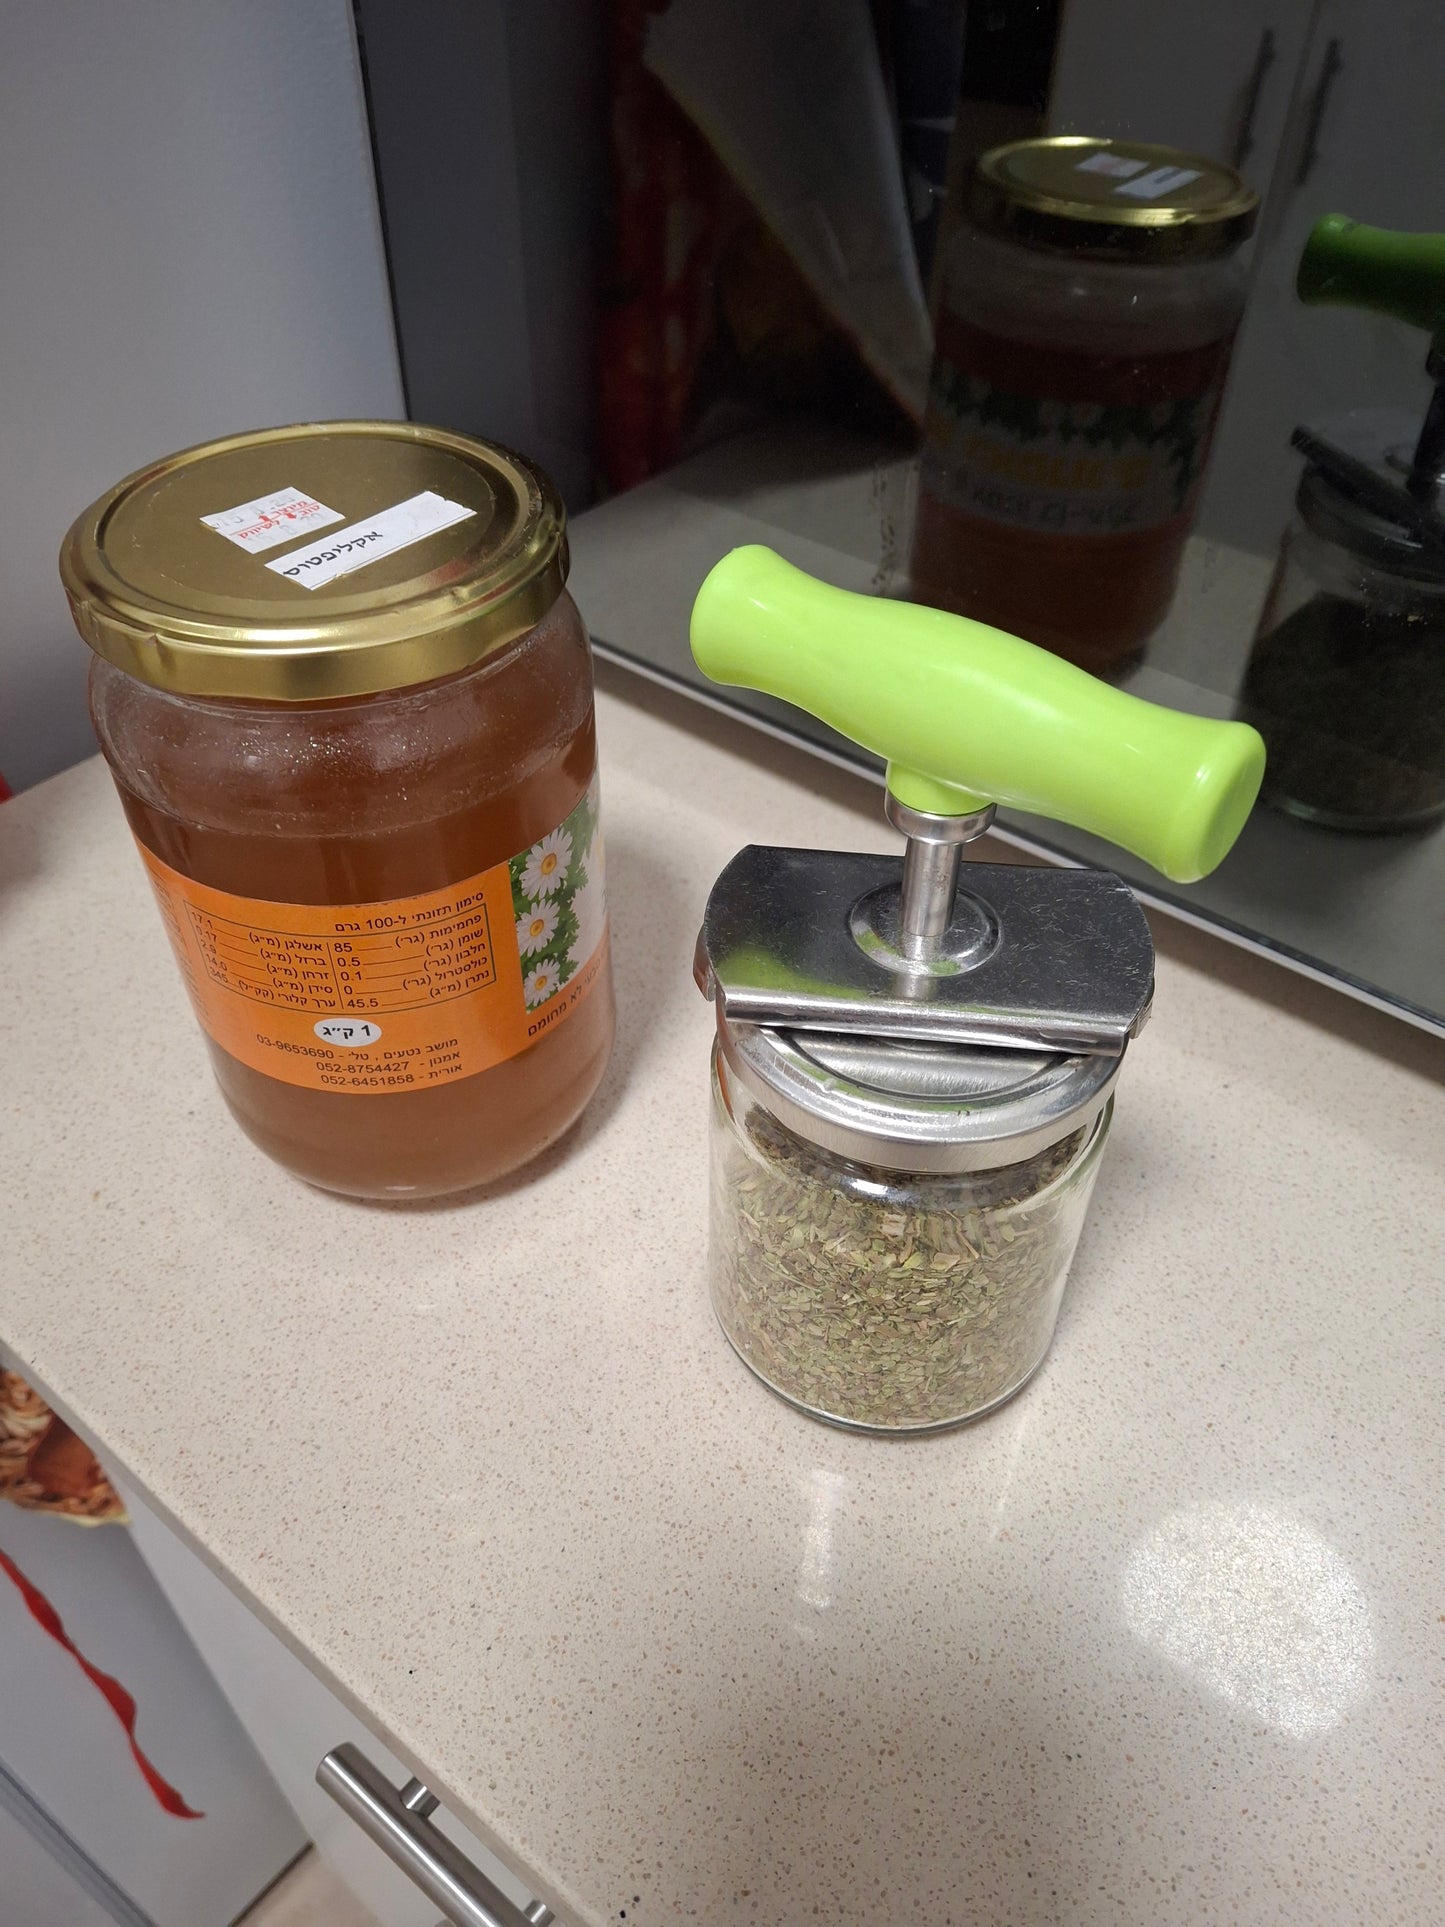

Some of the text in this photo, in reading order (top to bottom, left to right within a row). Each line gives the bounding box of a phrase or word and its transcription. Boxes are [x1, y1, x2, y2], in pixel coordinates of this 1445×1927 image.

[283, 531, 383, 575] אקליפטוס
[335, 892, 484, 932] סימון תזונתי ל-100 גרם
[429, 914, 482, 939] פחמימות
[458, 928, 484, 947] שומן
[285, 940, 324, 951] אשלגן
[334, 943, 353, 953] 85
[456, 942, 486, 961] חלבון
[295, 954, 327, 966] ברזל
[337, 957, 361, 967] 0.5
[302, 970, 329, 981] זרחן
[435, 956, 488, 981] כולסטרול
[340, 971, 362, 981] 0.1
[465, 969, 490, 988] נתרן
[309, 984, 333, 994] סידן
[343, 985, 353, 995] 0
[570, 984, 583, 1004] לא
[278, 992, 308, 1007] קלורי
[312, 998, 336, 1009] ערך
[347, 998, 379, 1009] 45.5
[528, 1002, 567, 1037] מחומם
[361, 1024, 370, 1036] 1
[256, 1034, 334, 1059] 03-9653690
[425, 1038, 458, 1053] מושב
[384, 1047, 421, 1060] נטעים
[429, 1051, 461, 1068] אמנון
[316, 1061, 409, 1074] 052-8754427
[428, 1064, 463, 1079] אורית
[320, 1073, 415, 1086] 052-6451858
